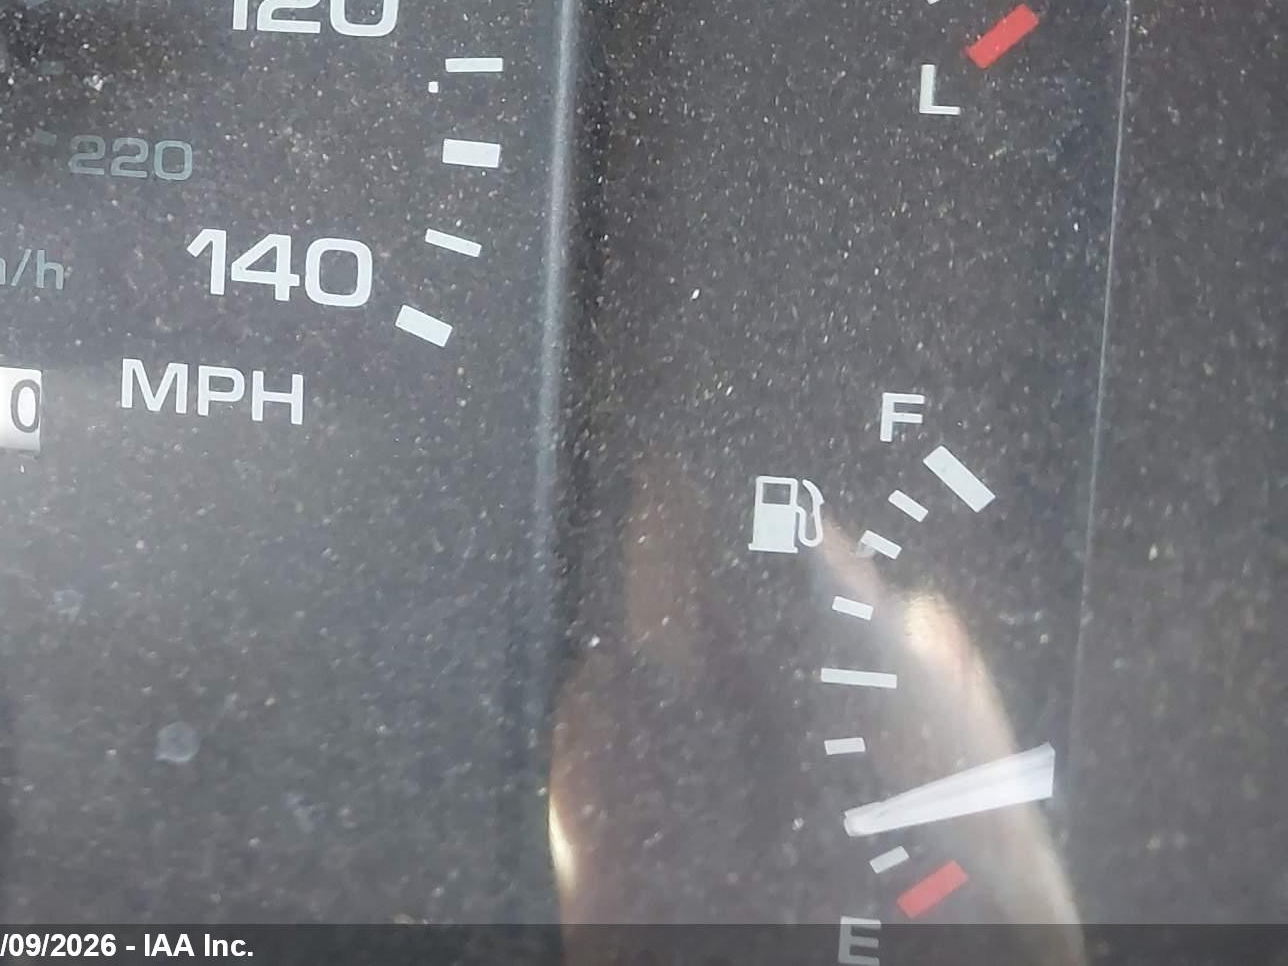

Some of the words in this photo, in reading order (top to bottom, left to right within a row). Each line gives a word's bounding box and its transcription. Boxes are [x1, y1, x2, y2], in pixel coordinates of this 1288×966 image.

[919, 64, 961, 115] L
[68, 135, 194, 181] 220
[187, 229, 373, 308] 140
[120, 358, 304, 426] MPH
[880, 392, 925, 442] F
[838, 916, 881, 966] E
